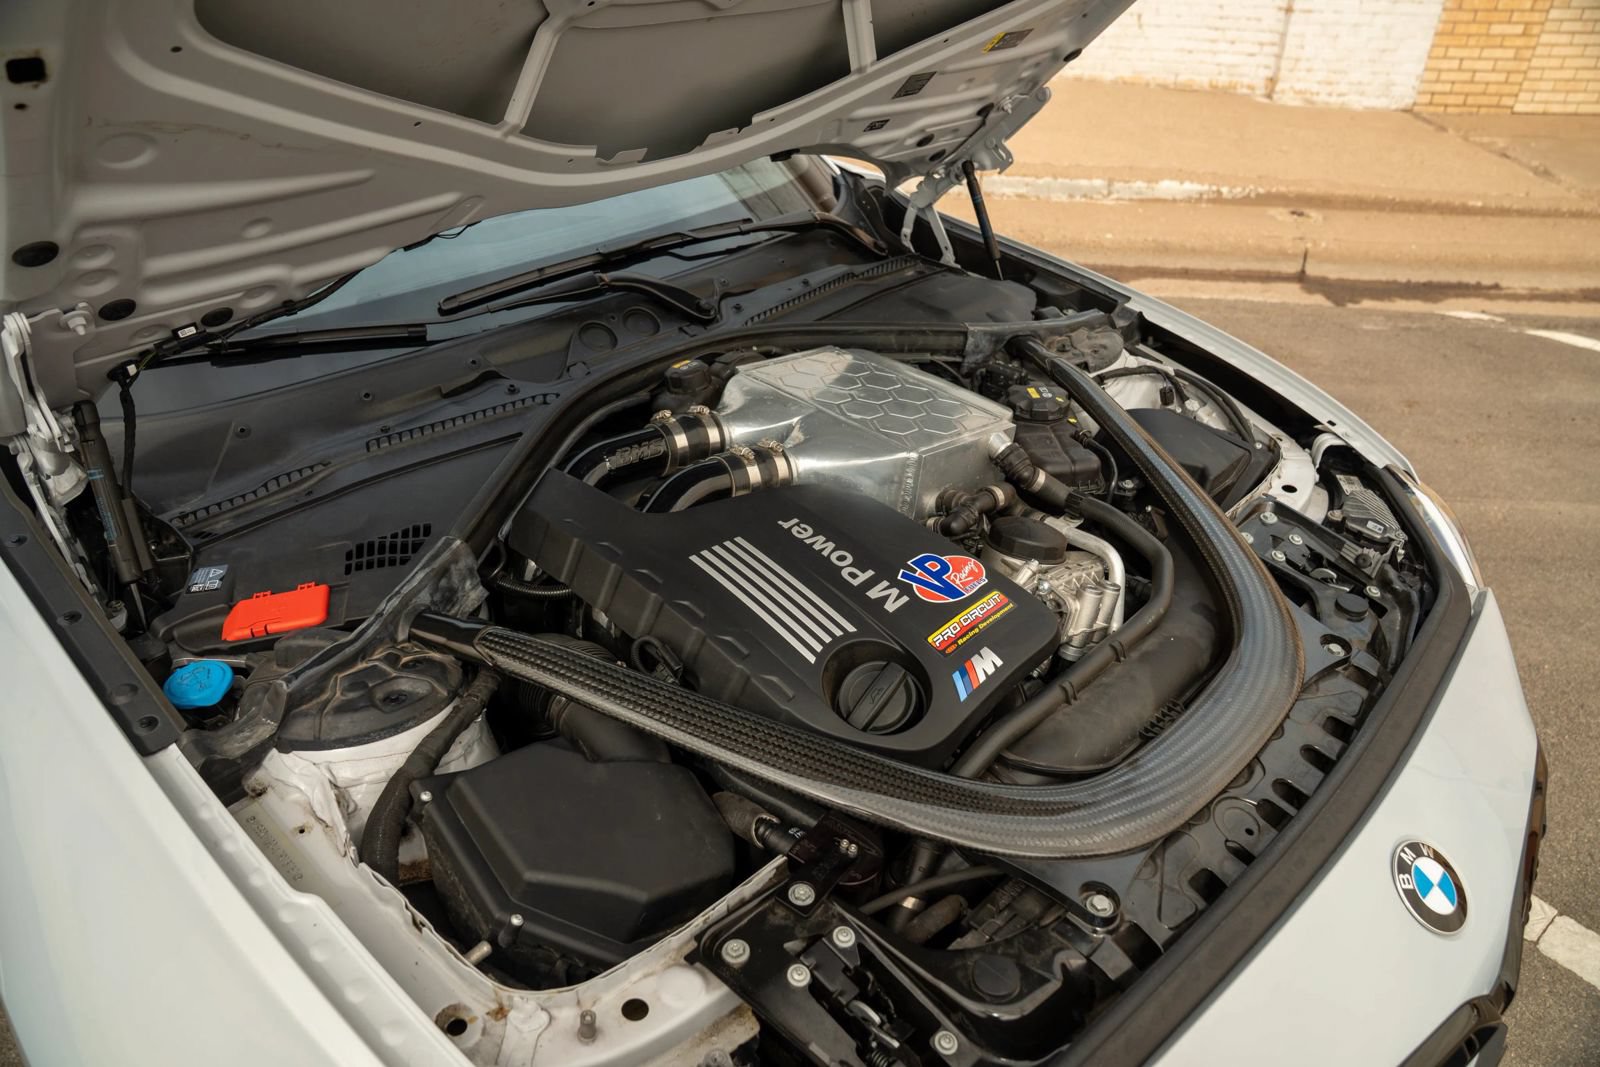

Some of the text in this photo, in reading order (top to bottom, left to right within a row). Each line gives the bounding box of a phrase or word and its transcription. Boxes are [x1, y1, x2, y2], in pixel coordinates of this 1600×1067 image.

[777, 518, 910, 613] M Power
[898, 553, 967, 601] VP
[950, 560, 979, 588] Racing
[964, 577, 987, 594] FUELS
[932, 594, 1001, 647] PRO CIRCUIT
[957, 602, 1014, 645] Racing Development
[1398, 842, 1434, 890] BMW
